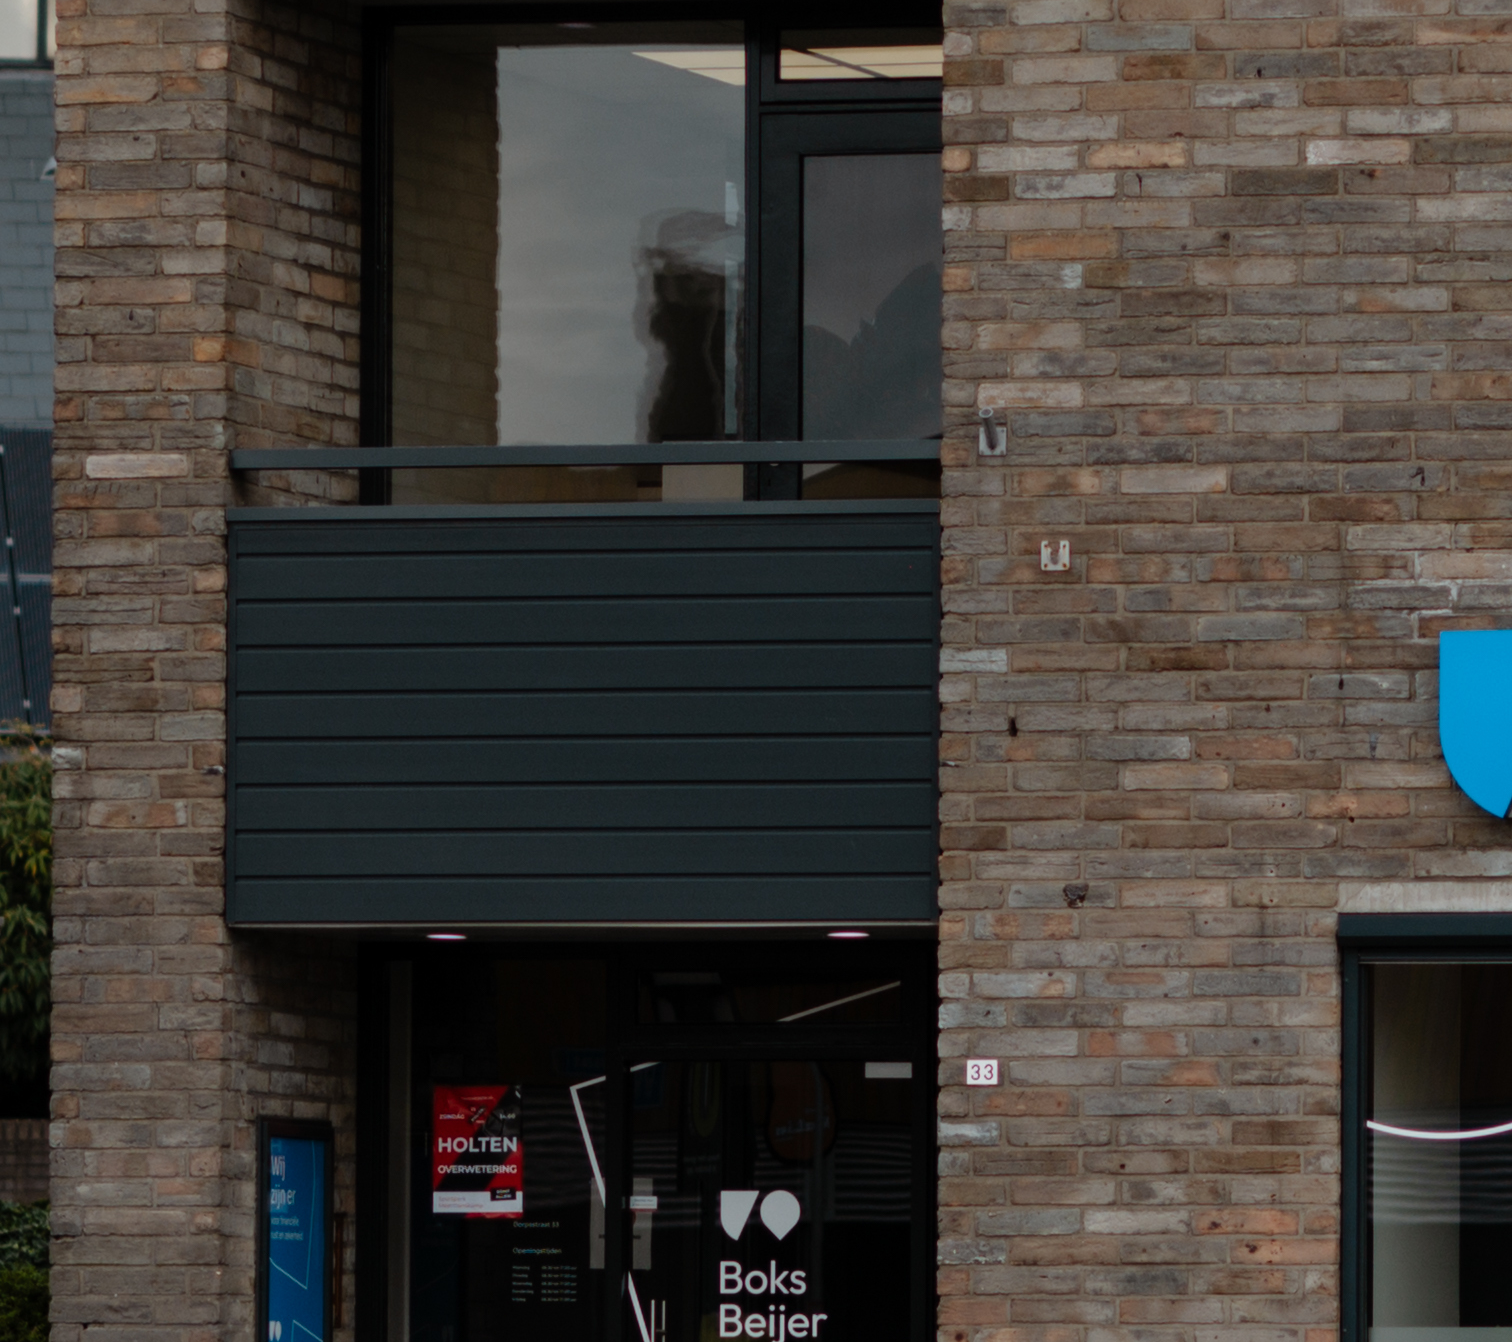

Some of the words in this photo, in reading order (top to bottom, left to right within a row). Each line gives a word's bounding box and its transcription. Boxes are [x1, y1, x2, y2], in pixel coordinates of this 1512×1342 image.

[970, 1064, 994, 1081] 33
[437, 1136, 518, 1153] HOLTEN
[270, 1155, 286, 1182] Wij
[437, 1164, 518, 1174] OVERWETERING
[719, 1260, 808, 1295] Boks
